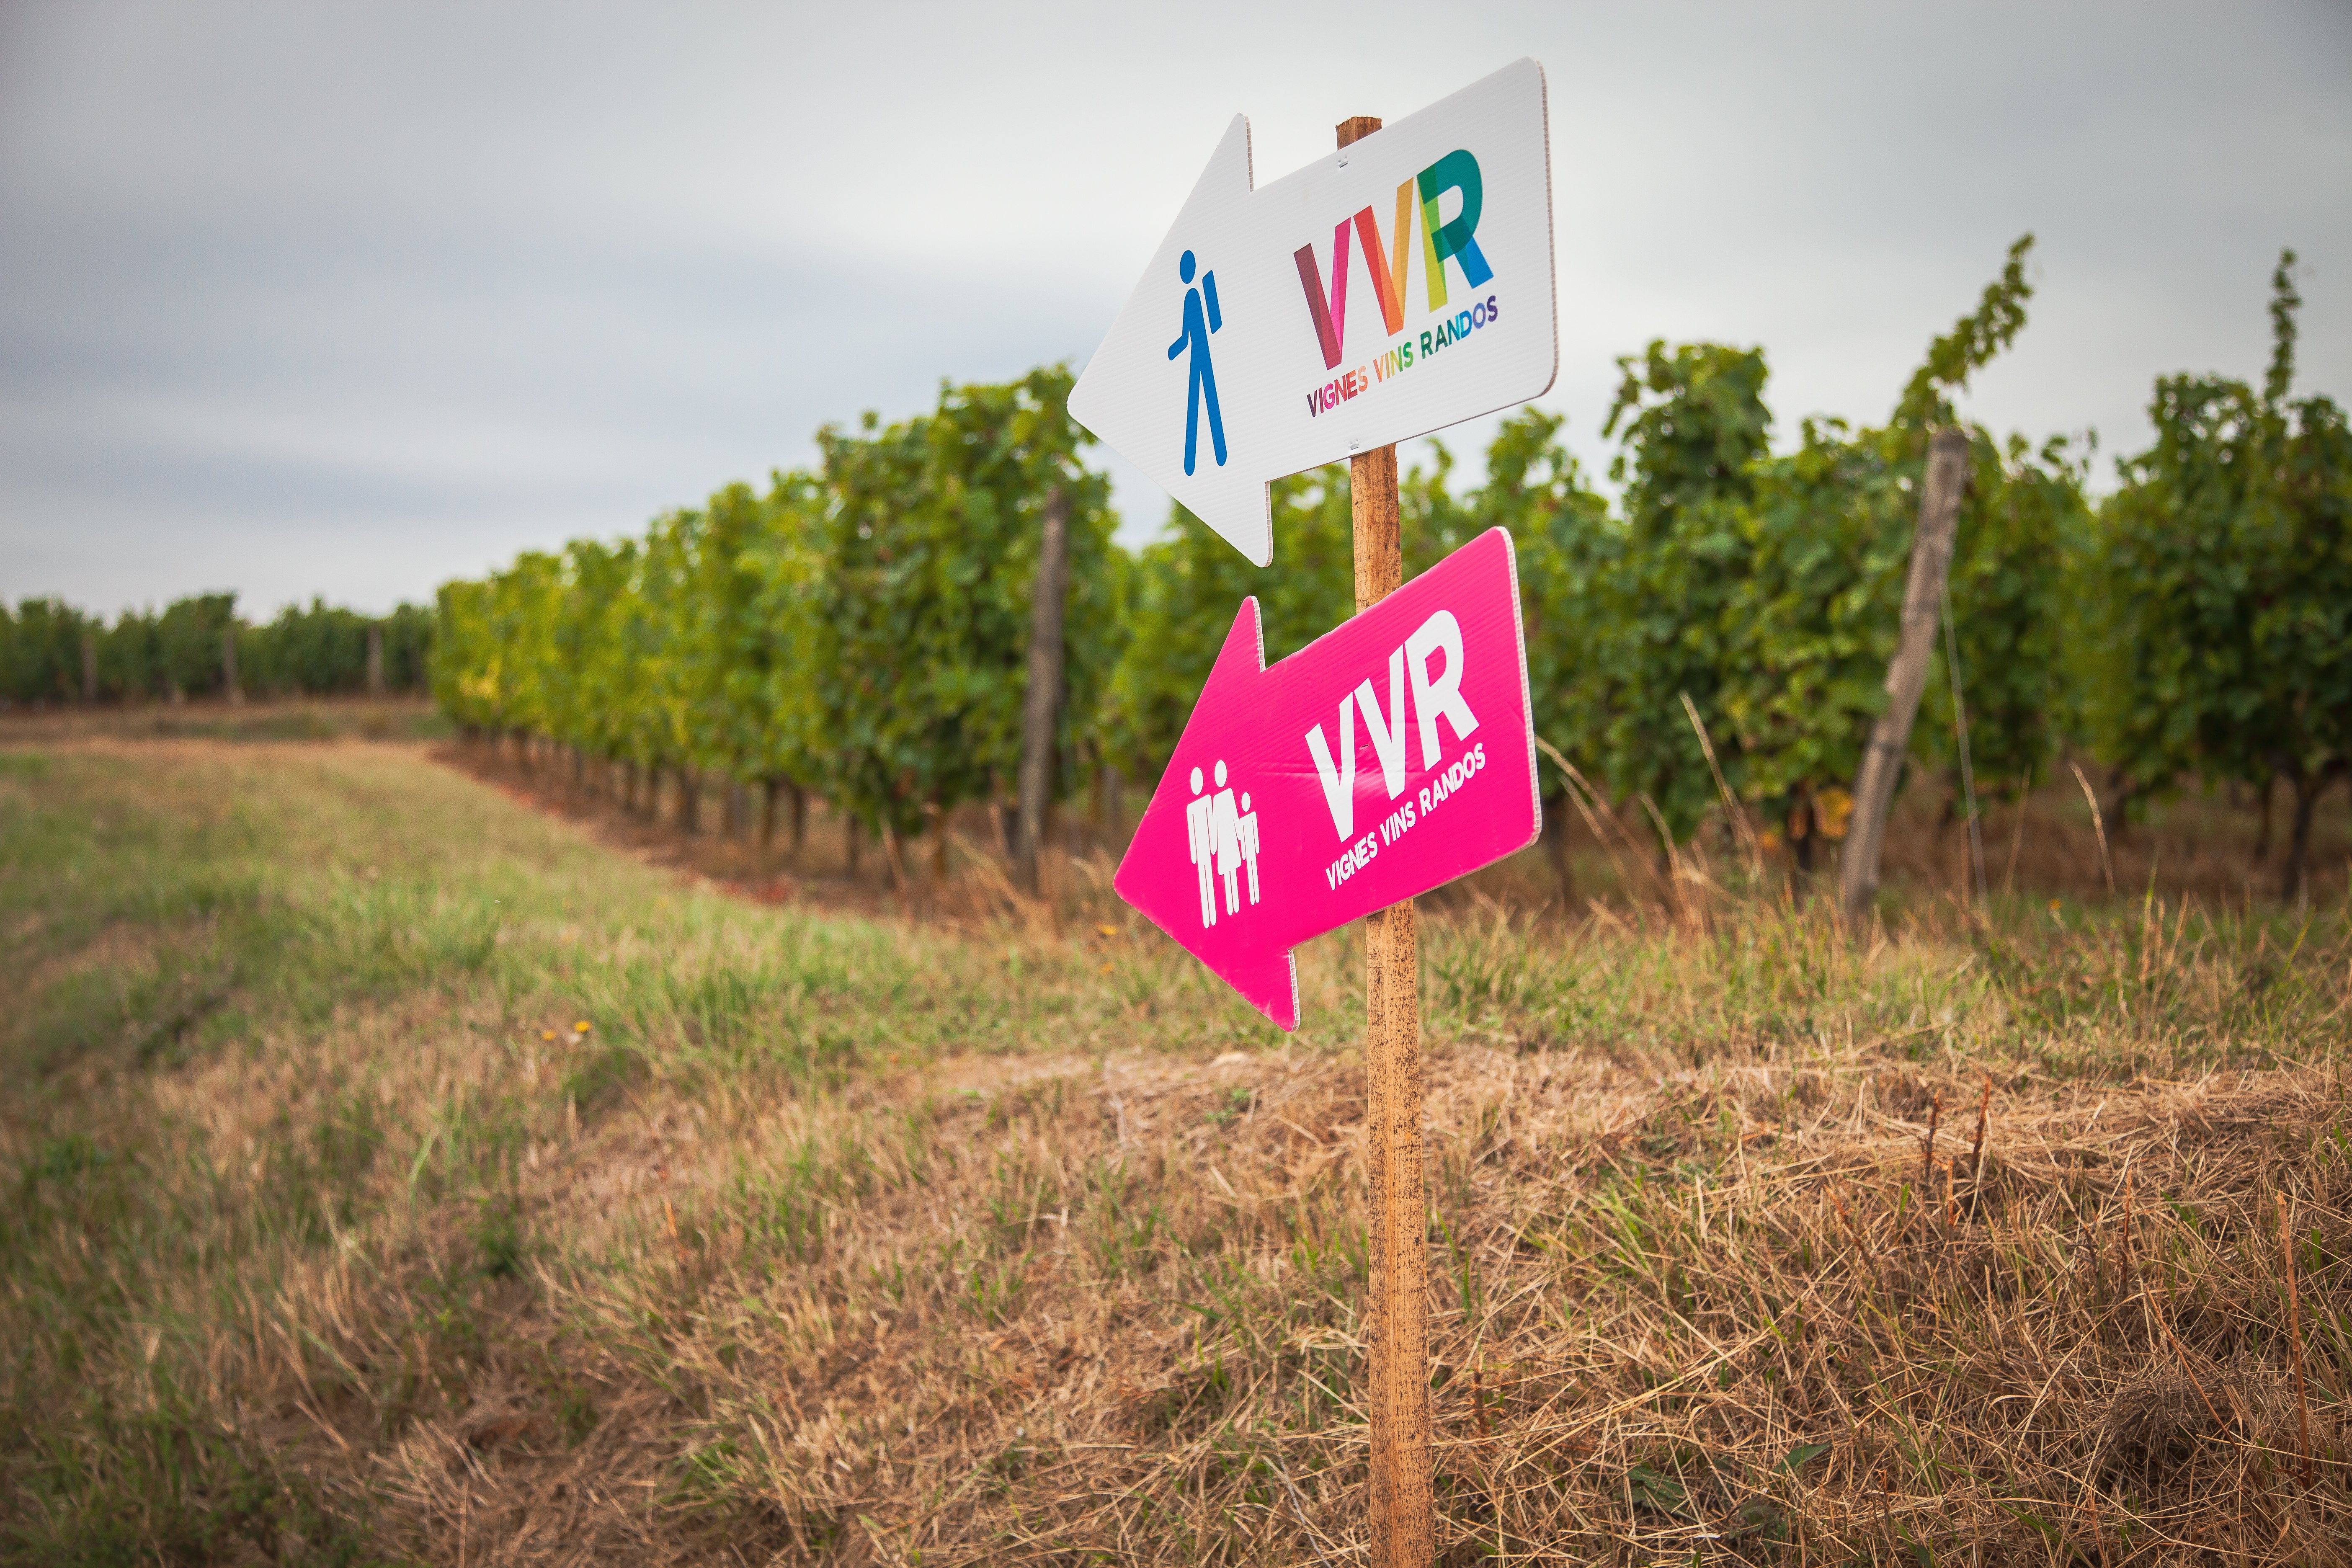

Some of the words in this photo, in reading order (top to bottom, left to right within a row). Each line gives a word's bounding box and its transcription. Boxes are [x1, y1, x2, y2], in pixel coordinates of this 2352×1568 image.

[1293, 149, 1494, 371] VVR
[1307, 366, 1368, 418] VIGNES
[1373, 341, 1413, 383] VINS
[1420, 295, 1498, 360] RANDOS
[1305, 610, 1480, 843] VVR
[1326, 832, 1377, 890] VIGNES
[1380, 802, 1416, 846] VINS
[1419, 743, 1485, 817] RANDOS
